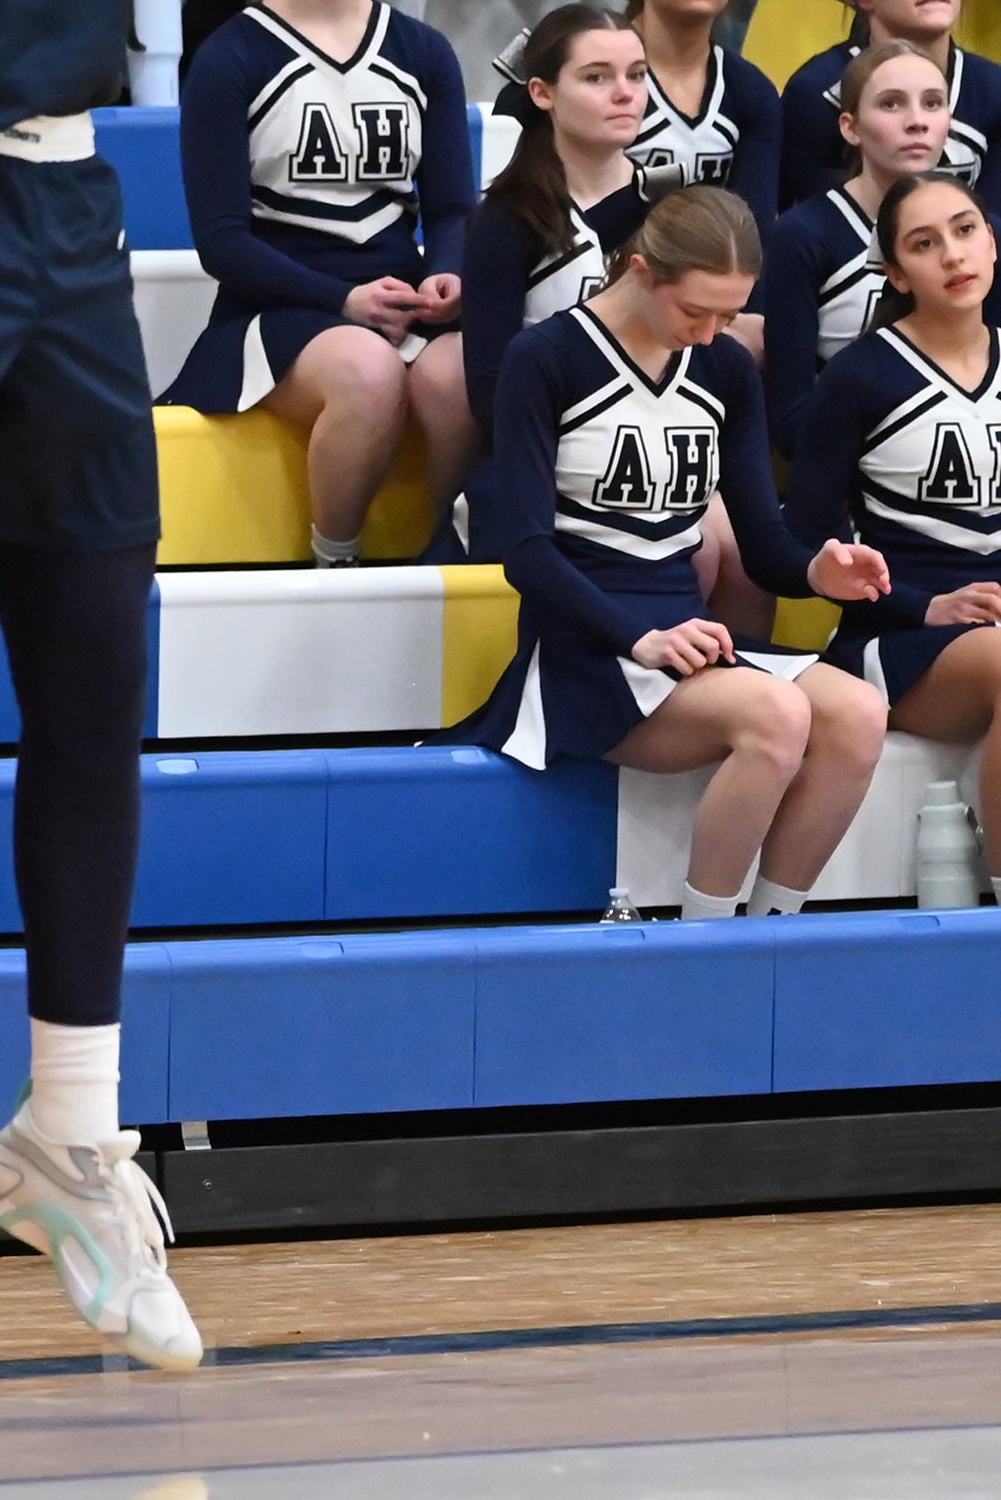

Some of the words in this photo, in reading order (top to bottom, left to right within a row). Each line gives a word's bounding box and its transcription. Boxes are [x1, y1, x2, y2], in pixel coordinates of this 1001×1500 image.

[288, 102, 410, 182] AH
[592, 424, 716, 510] AH
[917, 422, 1001, 506] A
